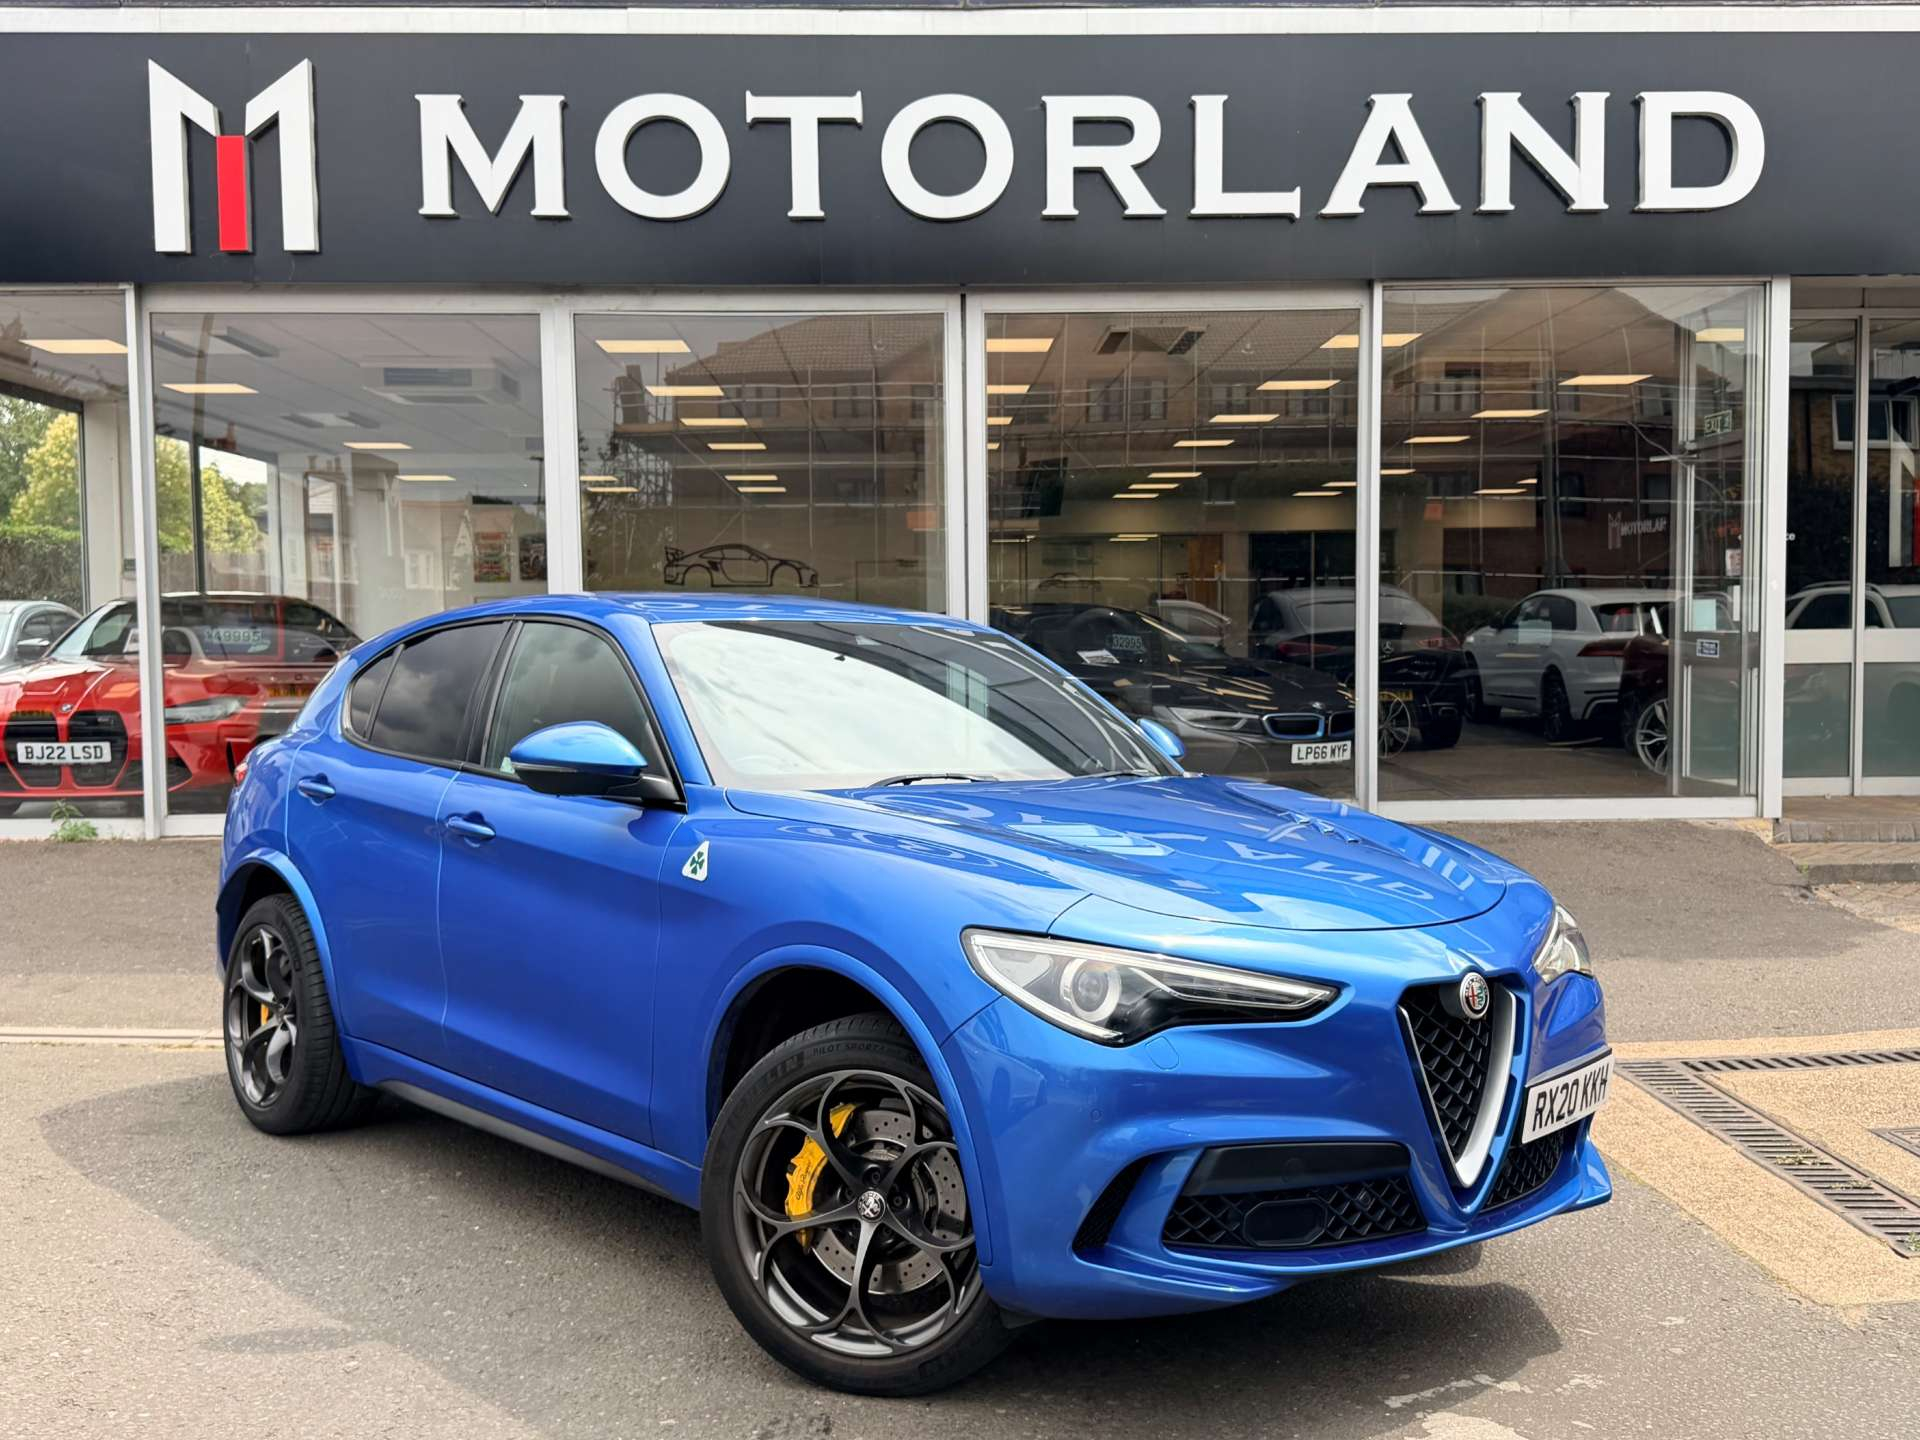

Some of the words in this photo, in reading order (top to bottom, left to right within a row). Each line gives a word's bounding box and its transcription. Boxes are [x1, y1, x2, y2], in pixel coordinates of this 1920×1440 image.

[414, 91, 1766, 221] MOTORLAND
[1704, 416, 1722, 434] EXIT
[1620, 516, 1667, 537] MOTORLA
[24, 744, 67, 761] BJ22
[70, 744, 104, 760] LSD
[1297, 745, 1328, 761] LP66
[812, 1043, 842, 1057] PILOT
[1532, 1077, 1580, 1132] RX20
[1579, 1063, 1610, 1112] KKH
